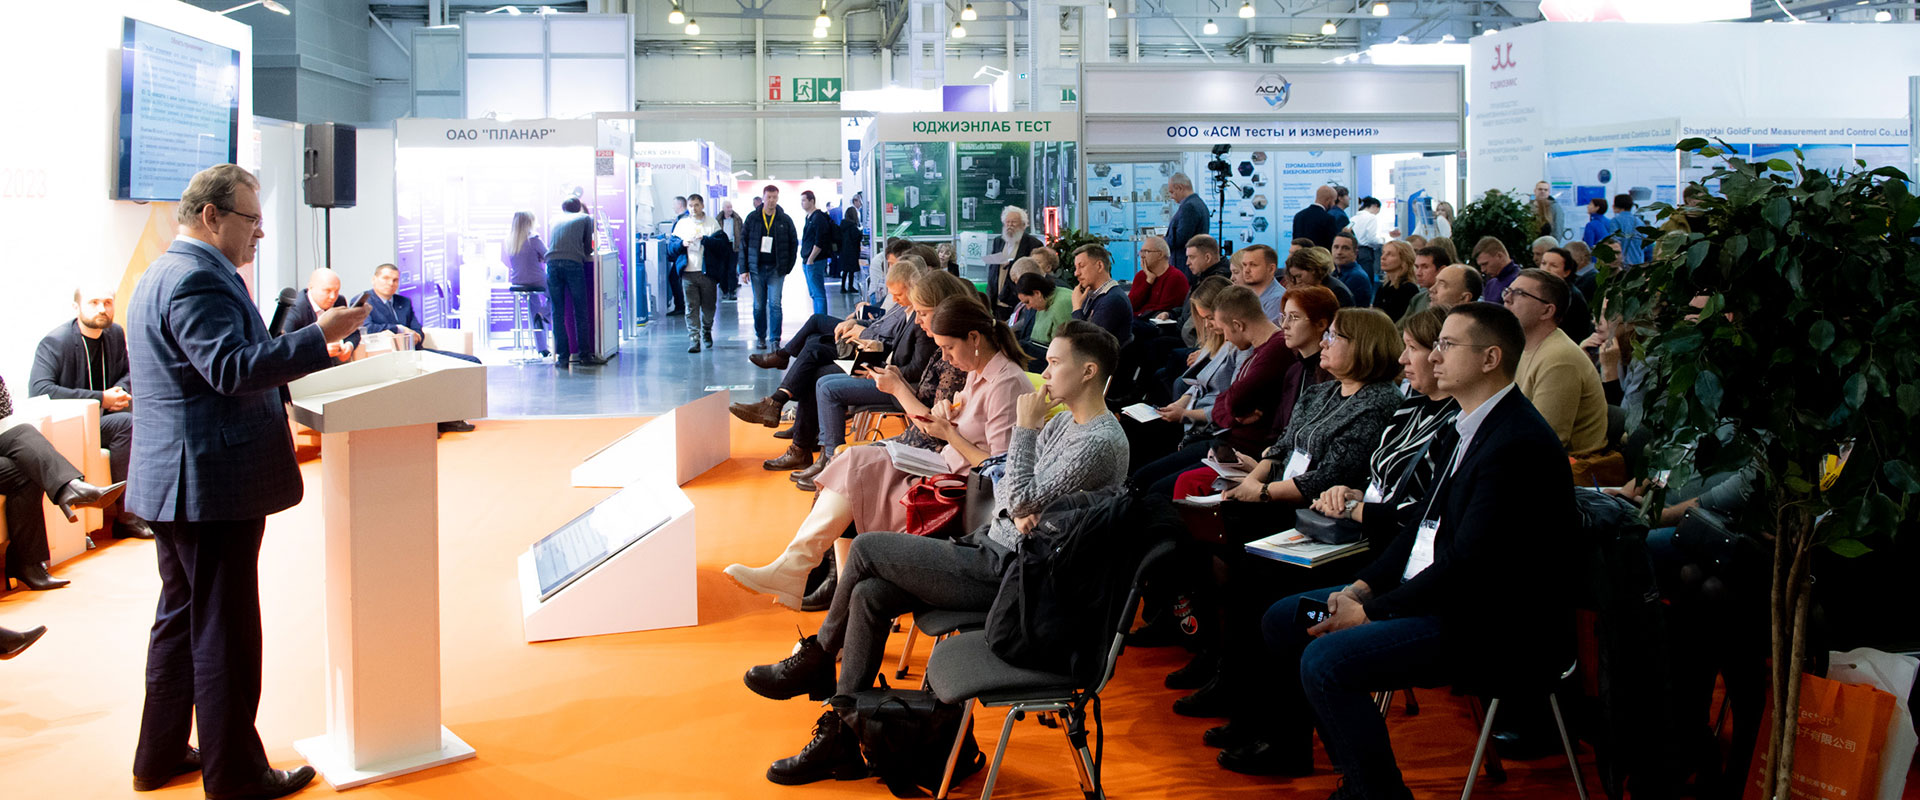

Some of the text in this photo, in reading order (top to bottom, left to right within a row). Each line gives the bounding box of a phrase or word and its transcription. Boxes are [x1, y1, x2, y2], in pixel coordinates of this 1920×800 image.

[912, 120, 1052, 135] ЮДЖИЭНЛАБ ТЕСТ
[1166, 126, 1379, 139] ООО «АСМ тесты и измерения»
[1683, 127, 1724, 137] ShangHai
[1726, 127, 1768, 136] GoldFund
[1770, 127, 1828, 137] Measurement
[1828, 127, 1844, 136] and
[1846, 127, 1877, 137] Control
[446, 128, 556, 141] ОАО "ПЛАНАР"
[1588, 133, 1620, 143] Measurement
[1620, 132, 1631, 140] and
[1631, 130, 1650, 139] Control
